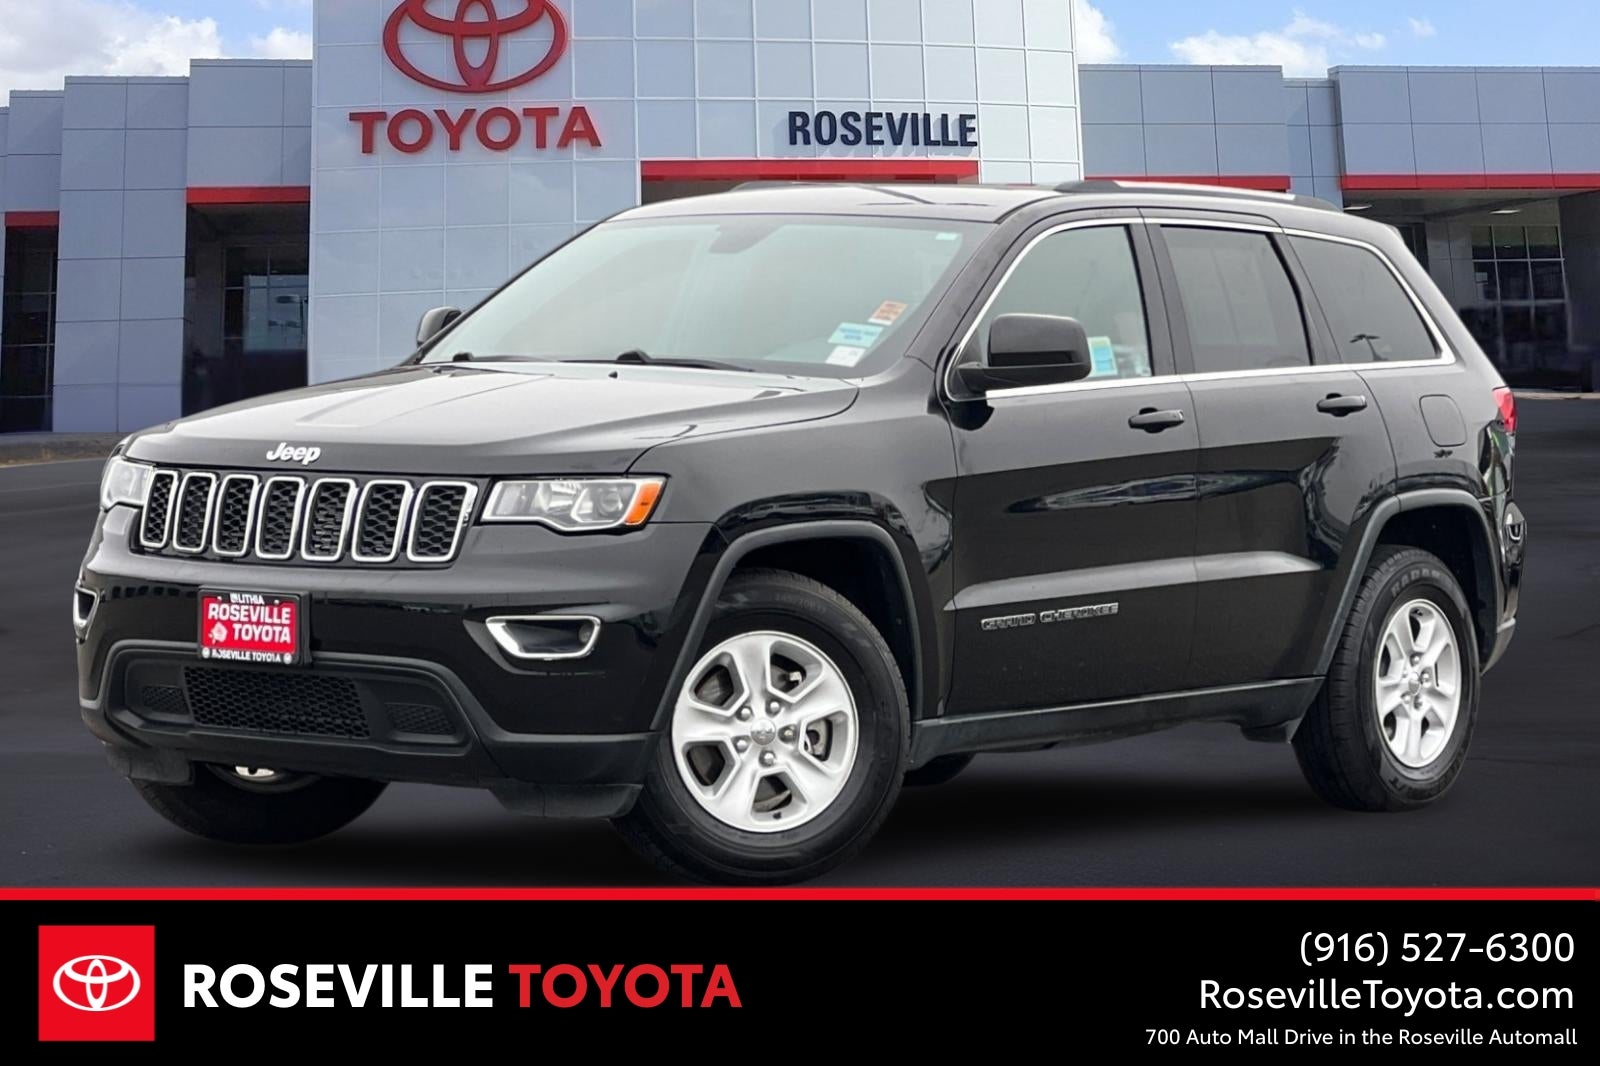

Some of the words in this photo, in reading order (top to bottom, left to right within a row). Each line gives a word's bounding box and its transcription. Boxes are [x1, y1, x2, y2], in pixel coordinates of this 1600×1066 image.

[349, 106, 602, 154] TOYOTA
[788, 111, 978, 147] ROSEVILLE
[266, 442, 321, 466] Jeep
[207, 602, 291, 625] ROSEVILLE
[981, 613, 1036, 631] GRAND
[1040, 602, 1119, 623] CHEROKEE
[232, 622, 291, 644] TOYOTA
[252, 652, 281, 663] TOYOTA
